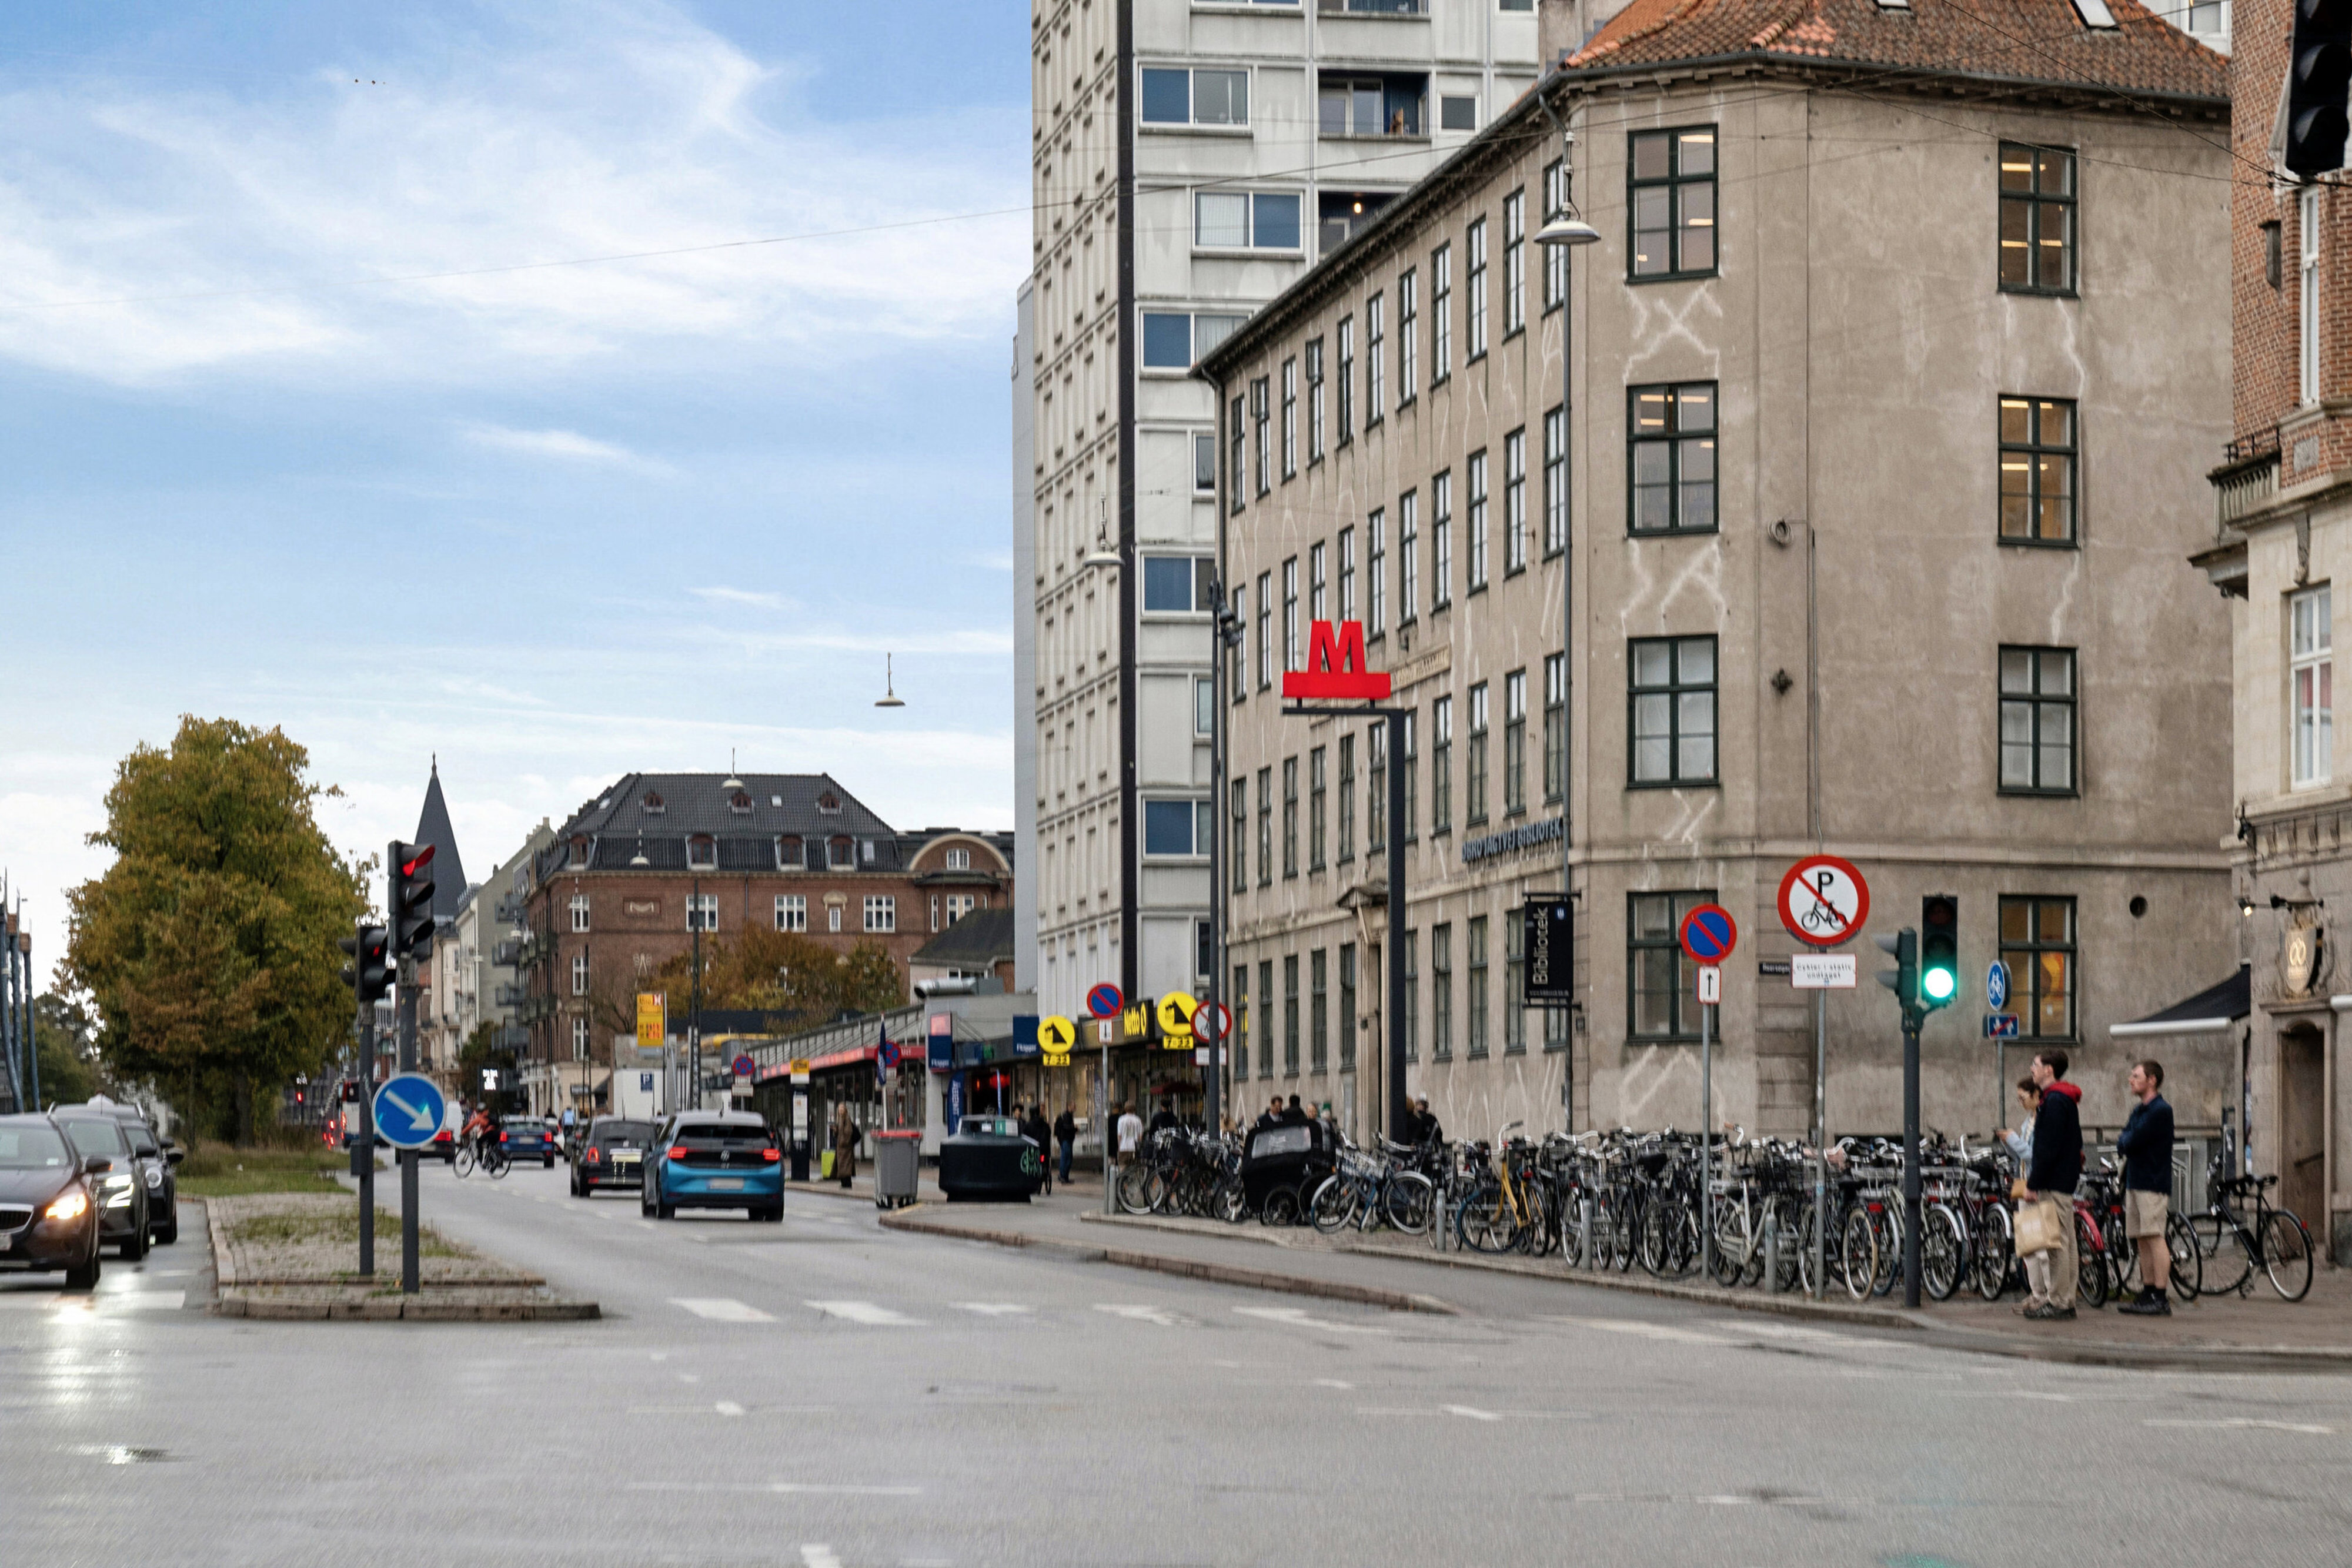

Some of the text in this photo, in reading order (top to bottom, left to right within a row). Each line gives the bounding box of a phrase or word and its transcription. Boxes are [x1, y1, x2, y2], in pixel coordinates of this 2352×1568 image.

[1484, 830, 1515, 858] JAGTVEJ
[1518, 817, 1561, 847] BIBLIOTEK
[1818, 871, 1834, 896] P
[1532, 906, 1549, 985] Bibliotek
[1124, 1007, 1140, 1037] Netto
